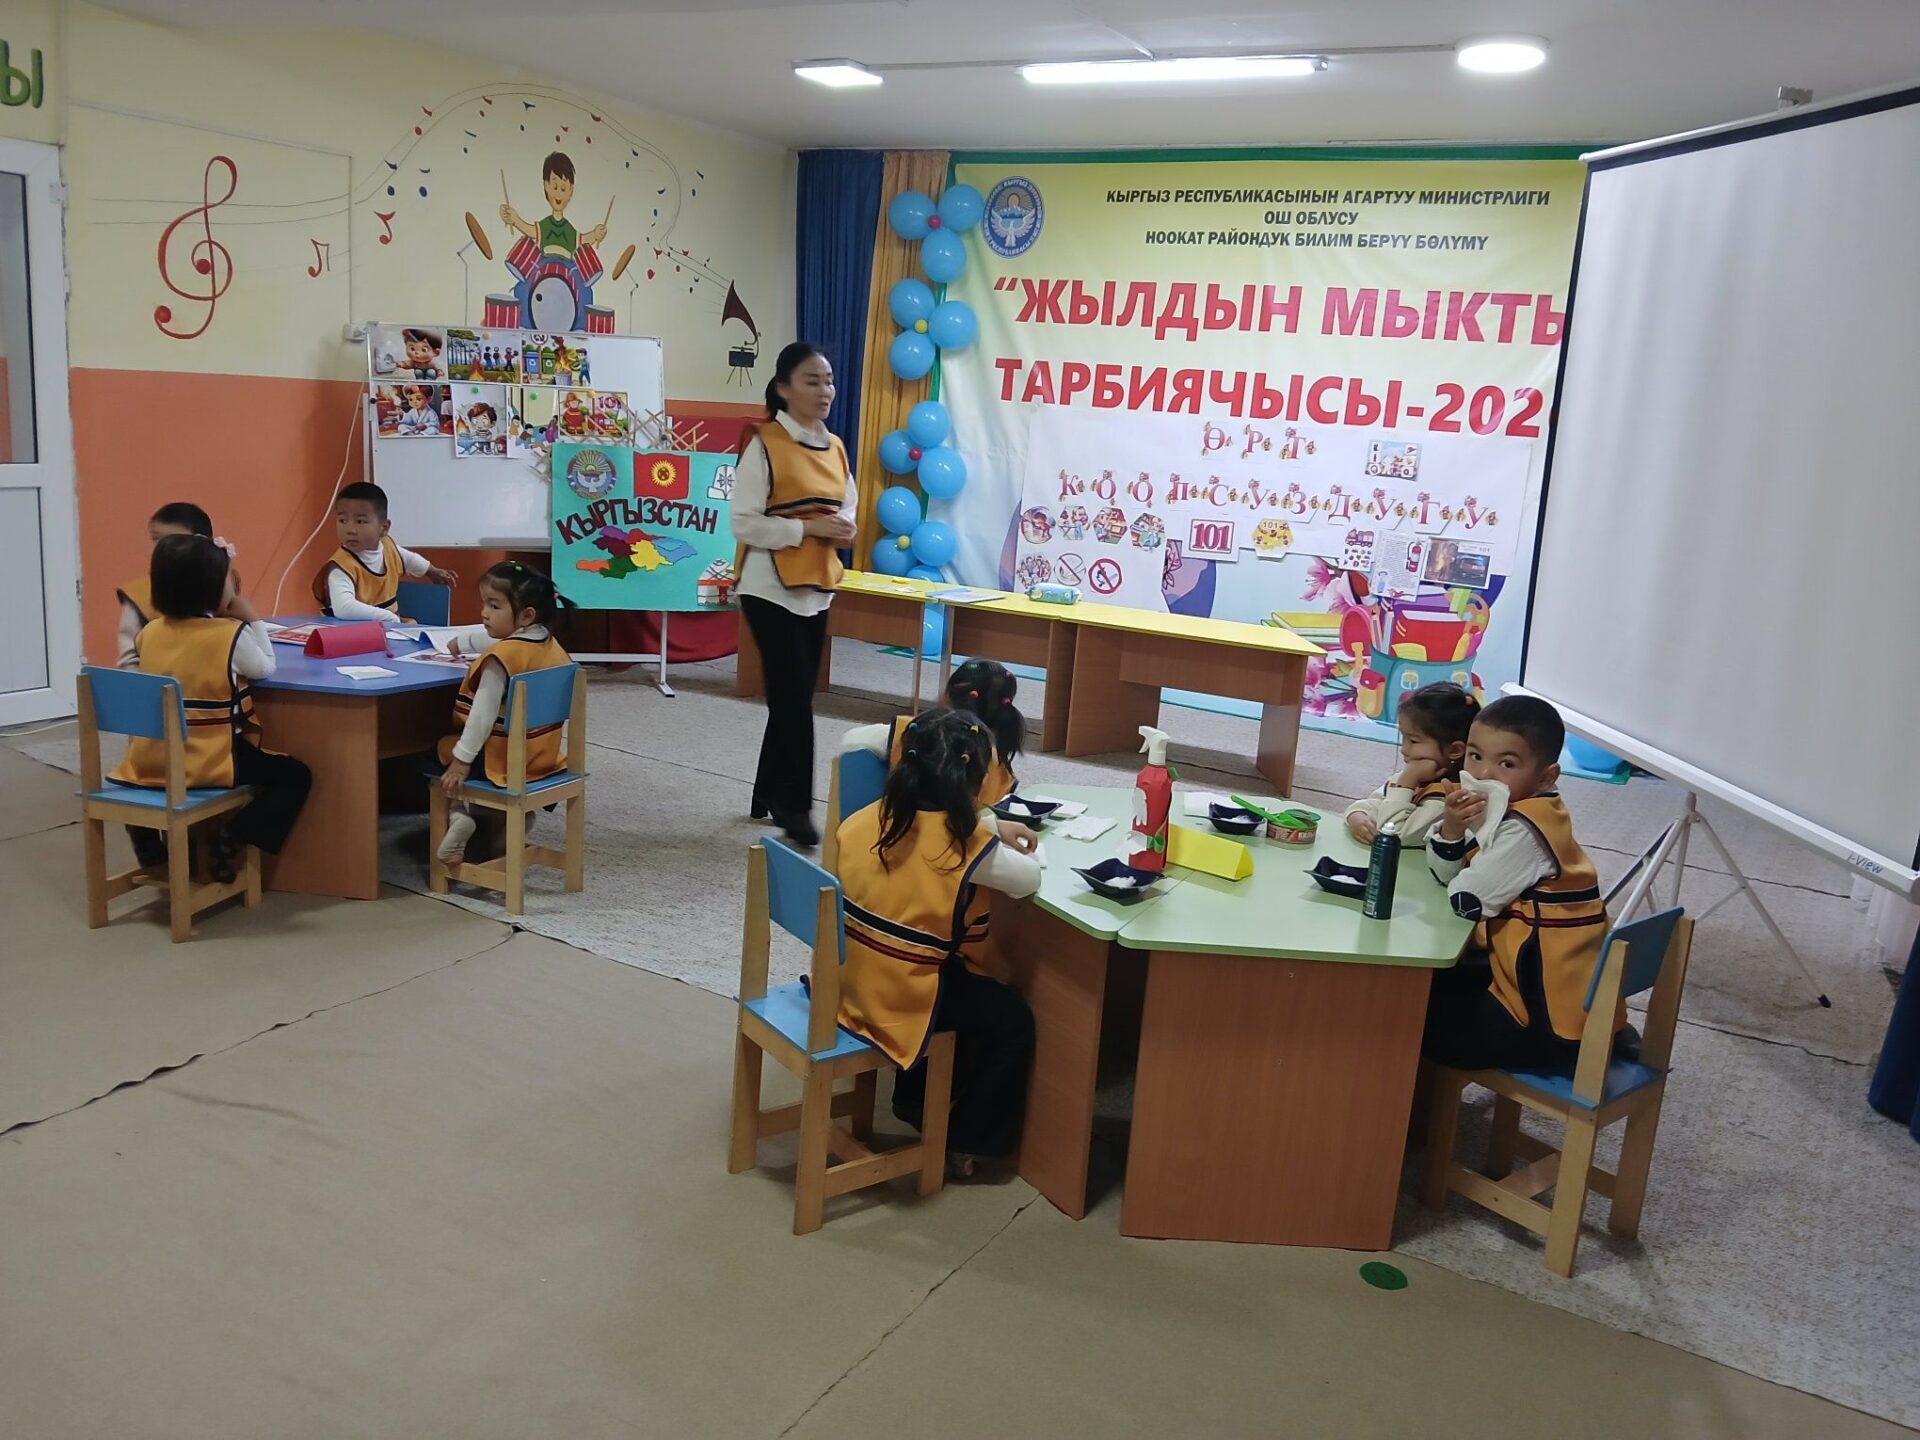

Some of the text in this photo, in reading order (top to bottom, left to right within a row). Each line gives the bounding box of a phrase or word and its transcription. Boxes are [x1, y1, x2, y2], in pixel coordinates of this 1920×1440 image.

[1106, 190, 1550, 205] КЫРГЫЗ РЕСПУБЛИКАСЫНЫН АГАРТУУ МИНИСТРЛИГИ
[1264, 211, 1359, 226] ОШ ОБЛУСУ
[1145, 228, 1489, 251] НООКАТ РАЙОНДУК БИЛИМ БЕРҮҮ БӨЛҮМҮ
[994, 357, 1555, 438] ТАРБИЯЧЫСЫ-202
[555, 497, 719, 545] КЫРГЫЗСТАН
[1263, 521, 1279, 529] 101
[1192, 523, 1230, 551] 101
